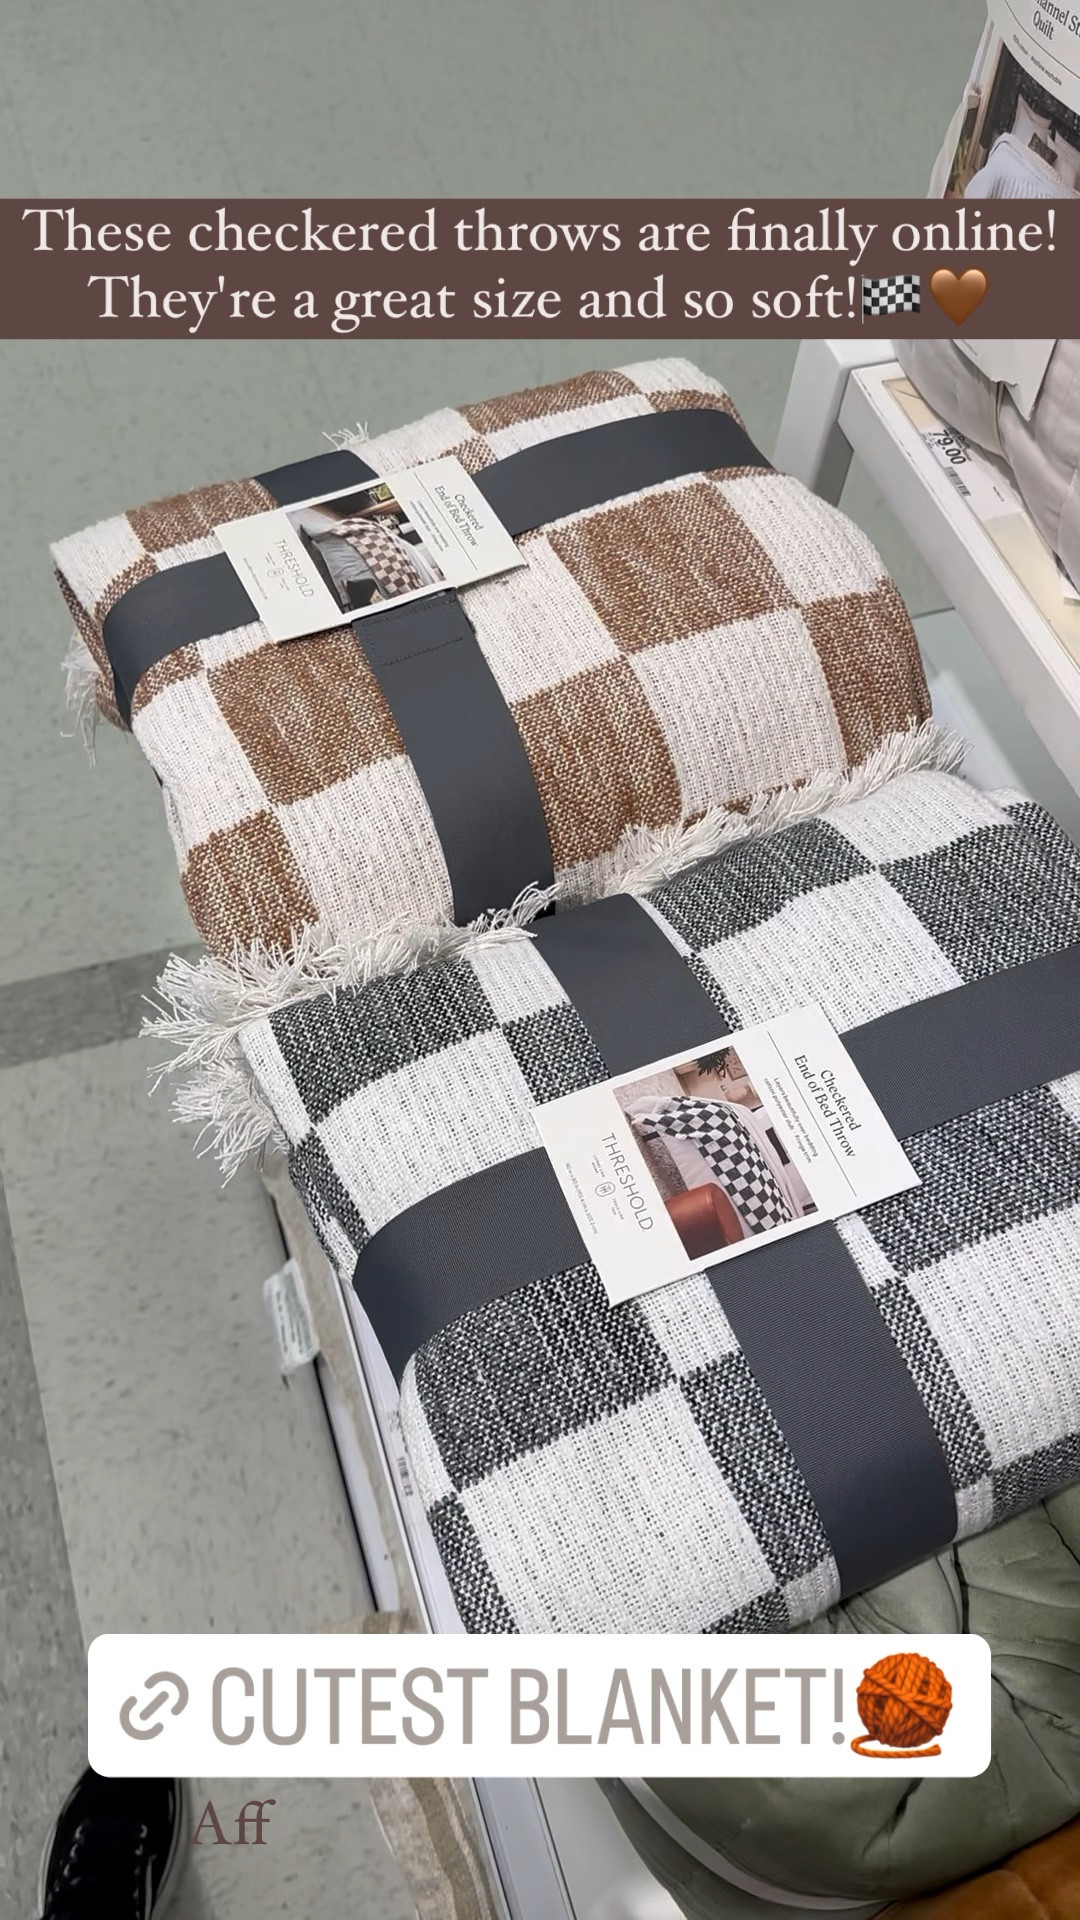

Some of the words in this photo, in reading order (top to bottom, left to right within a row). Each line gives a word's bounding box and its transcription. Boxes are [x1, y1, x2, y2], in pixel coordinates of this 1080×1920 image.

[1033, 10, 1054, 40] Quilt
[1068, 15, 1080, 38] St
[932, 428, 967, 465] 79.00
[435, 485, 450, 501] End
[444, 501, 456, 509] of
[449, 508, 465, 523] Bed
[455, 494, 484, 530] Checkered
[459, 522, 479, 546] Throw
[275, 538, 315, 599] THRESHOLD
[794, 1054, 816, 1080] End
[807, 1081, 824, 1093] of
[820, 1069, 862, 1131] Checkered
[814, 1093, 837, 1119] Bed
[829, 1117, 856, 1157] Throw
[602, 1132, 654, 1230] THRESHOLD
